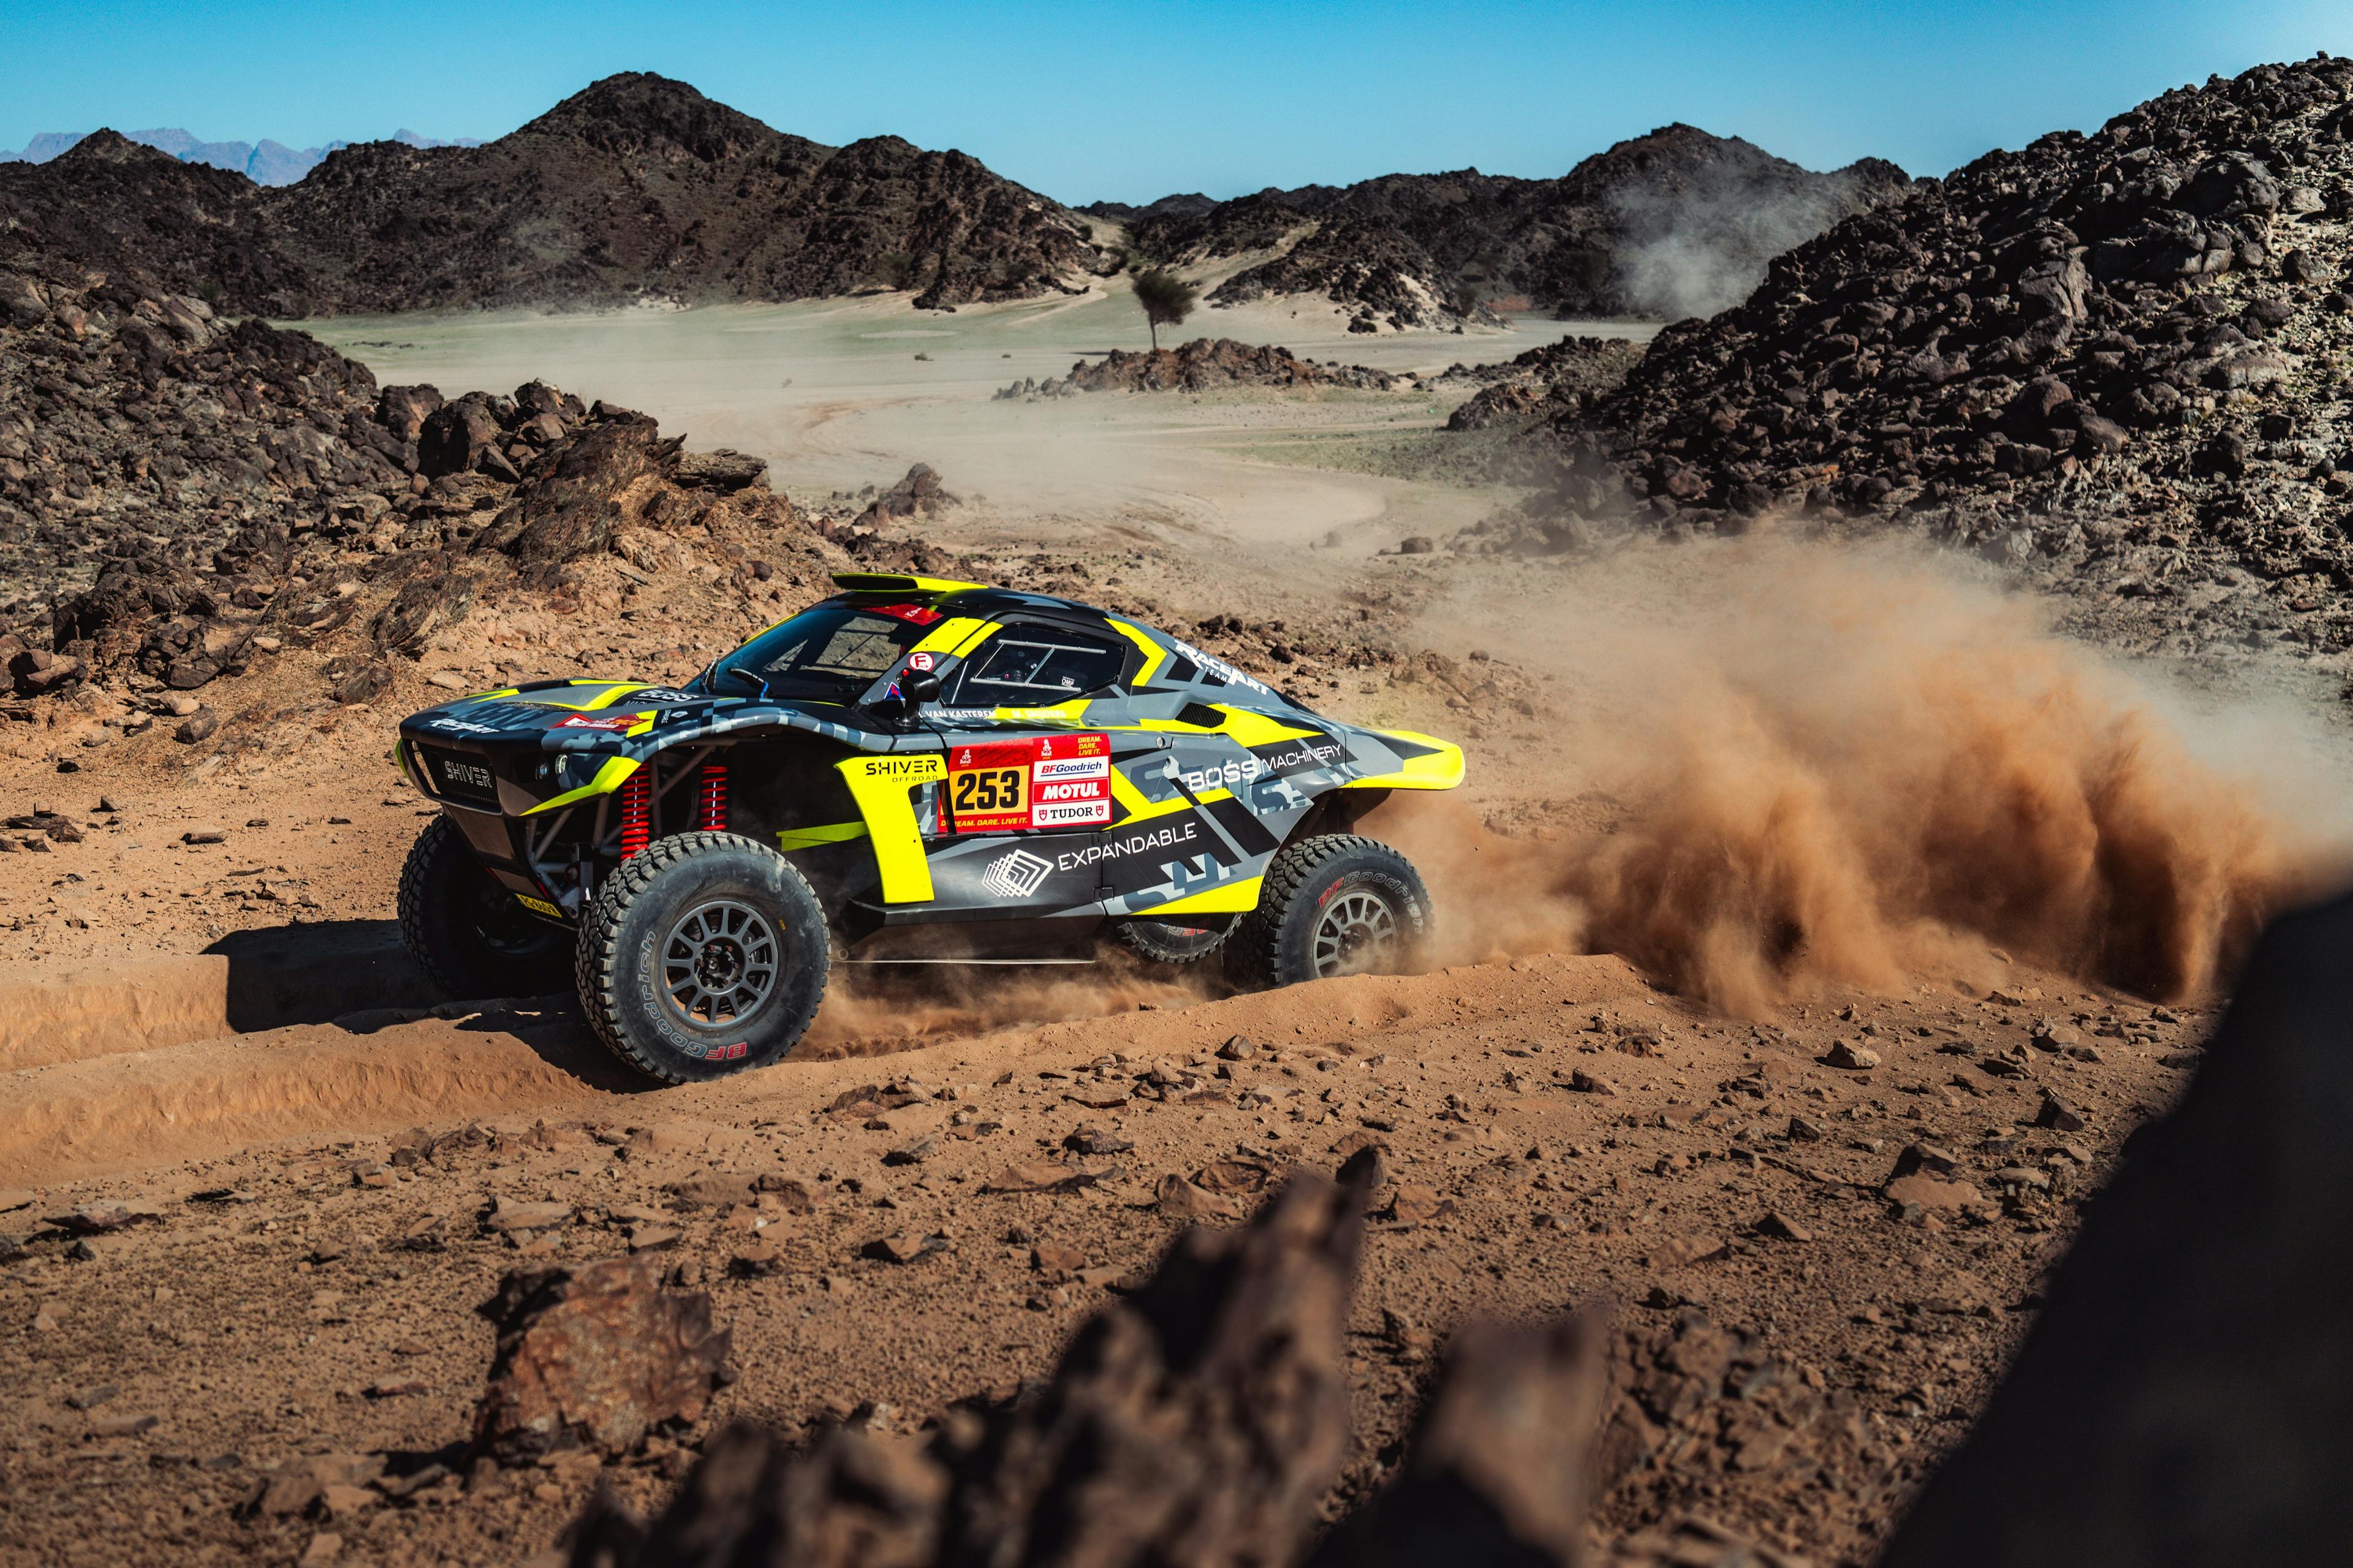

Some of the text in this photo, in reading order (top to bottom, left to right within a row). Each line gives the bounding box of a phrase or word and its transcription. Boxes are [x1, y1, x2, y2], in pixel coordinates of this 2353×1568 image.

[1061, 678, 1074, 686] OMP
[1205, 667, 1227, 683] TEAM
[444, 760, 493, 789] SHIVER
[866, 760, 937, 775] SHIVER
[1041, 762, 1102, 774] BFGoodrich
[1188, 744, 1342, 791] BOSS MACHINERY
[955, 770, 1020, 811] 253
[1042, 782, 1101, 800] MOTUL
[1050, 807, 1093, 819] TUDOR
[1058, 822, 1197, 871] EXPANDABLE
[1318, 871, 1424, 933] BFGoodrich
[638, 931, 747, 1060] BFGoodrich
